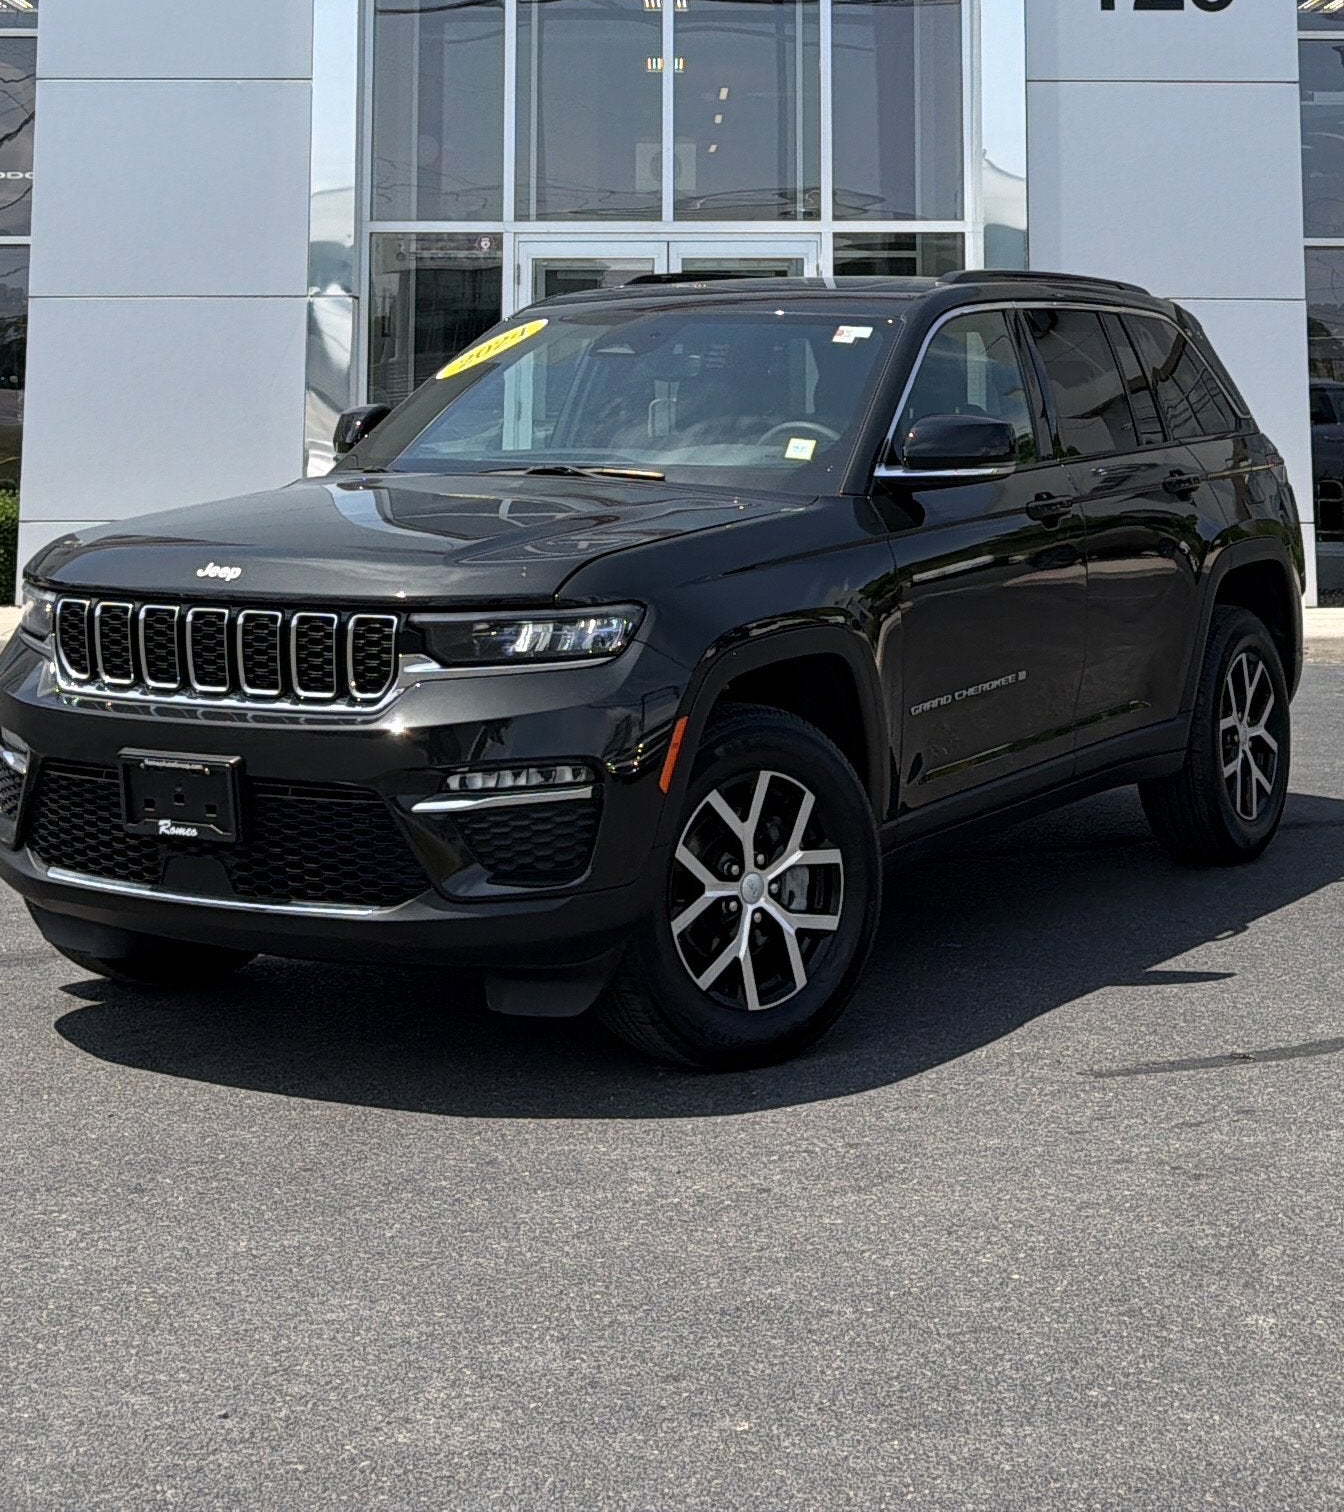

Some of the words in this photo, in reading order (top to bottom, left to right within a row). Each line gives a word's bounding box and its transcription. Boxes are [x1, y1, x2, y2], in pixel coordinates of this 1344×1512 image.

[196, 562, 242, 581] Jeep
[910, 694, 952, 716] GRAND
[954, 673, 1016, 701] CHEROKEE
